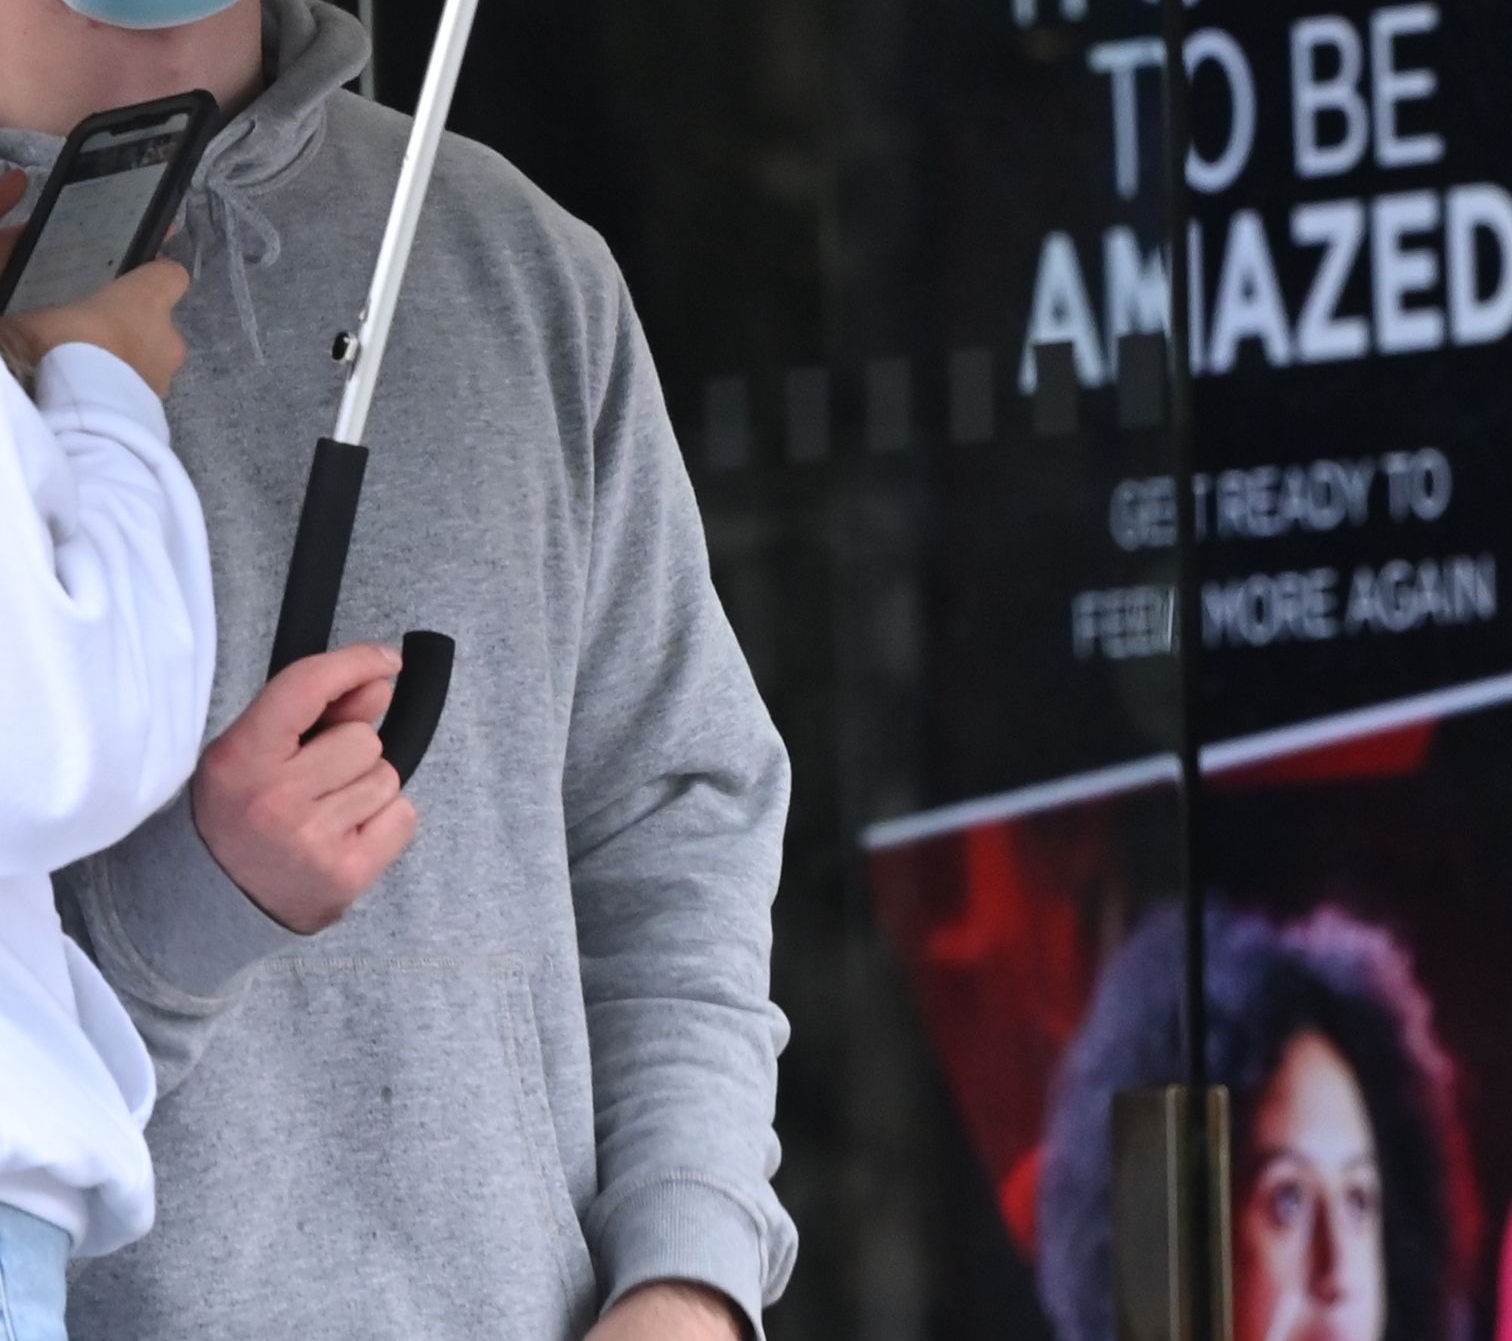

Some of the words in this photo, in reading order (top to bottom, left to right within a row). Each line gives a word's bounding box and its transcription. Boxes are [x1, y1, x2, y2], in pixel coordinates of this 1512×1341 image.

[1086, 28, 1257, 199] TO
[1290, 1, 1446, 179] BE
[1380, 446, 1453, 521] TO
[1344, 556, 1498, 633] AGAIN
